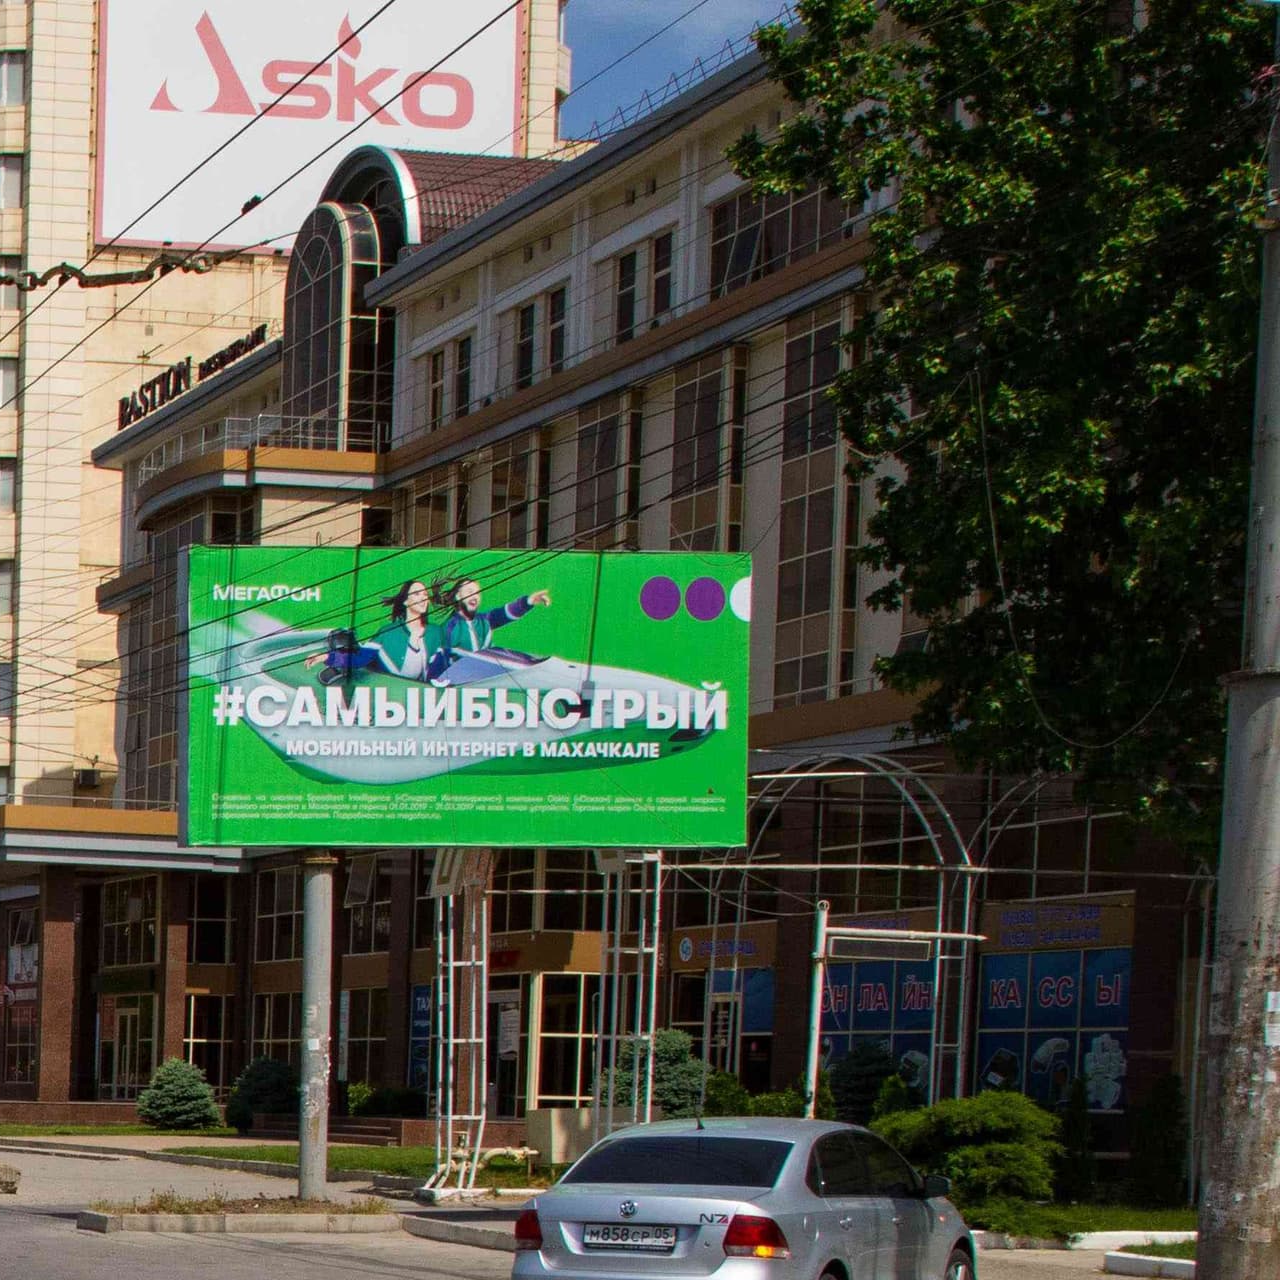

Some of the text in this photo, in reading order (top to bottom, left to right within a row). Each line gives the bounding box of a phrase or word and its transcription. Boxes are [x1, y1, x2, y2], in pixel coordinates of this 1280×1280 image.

[118, 356, 192, 431] BASTION
[213, 680, 727, 730] #САМЫЙБЫСТРЫЙ
[286, 737, 660, 759] МОБИЛЬНЫЙ ИНТЕРНЕТ В МАХАЧКАЛЕ
[654, 1228, 670, 1239] 05
